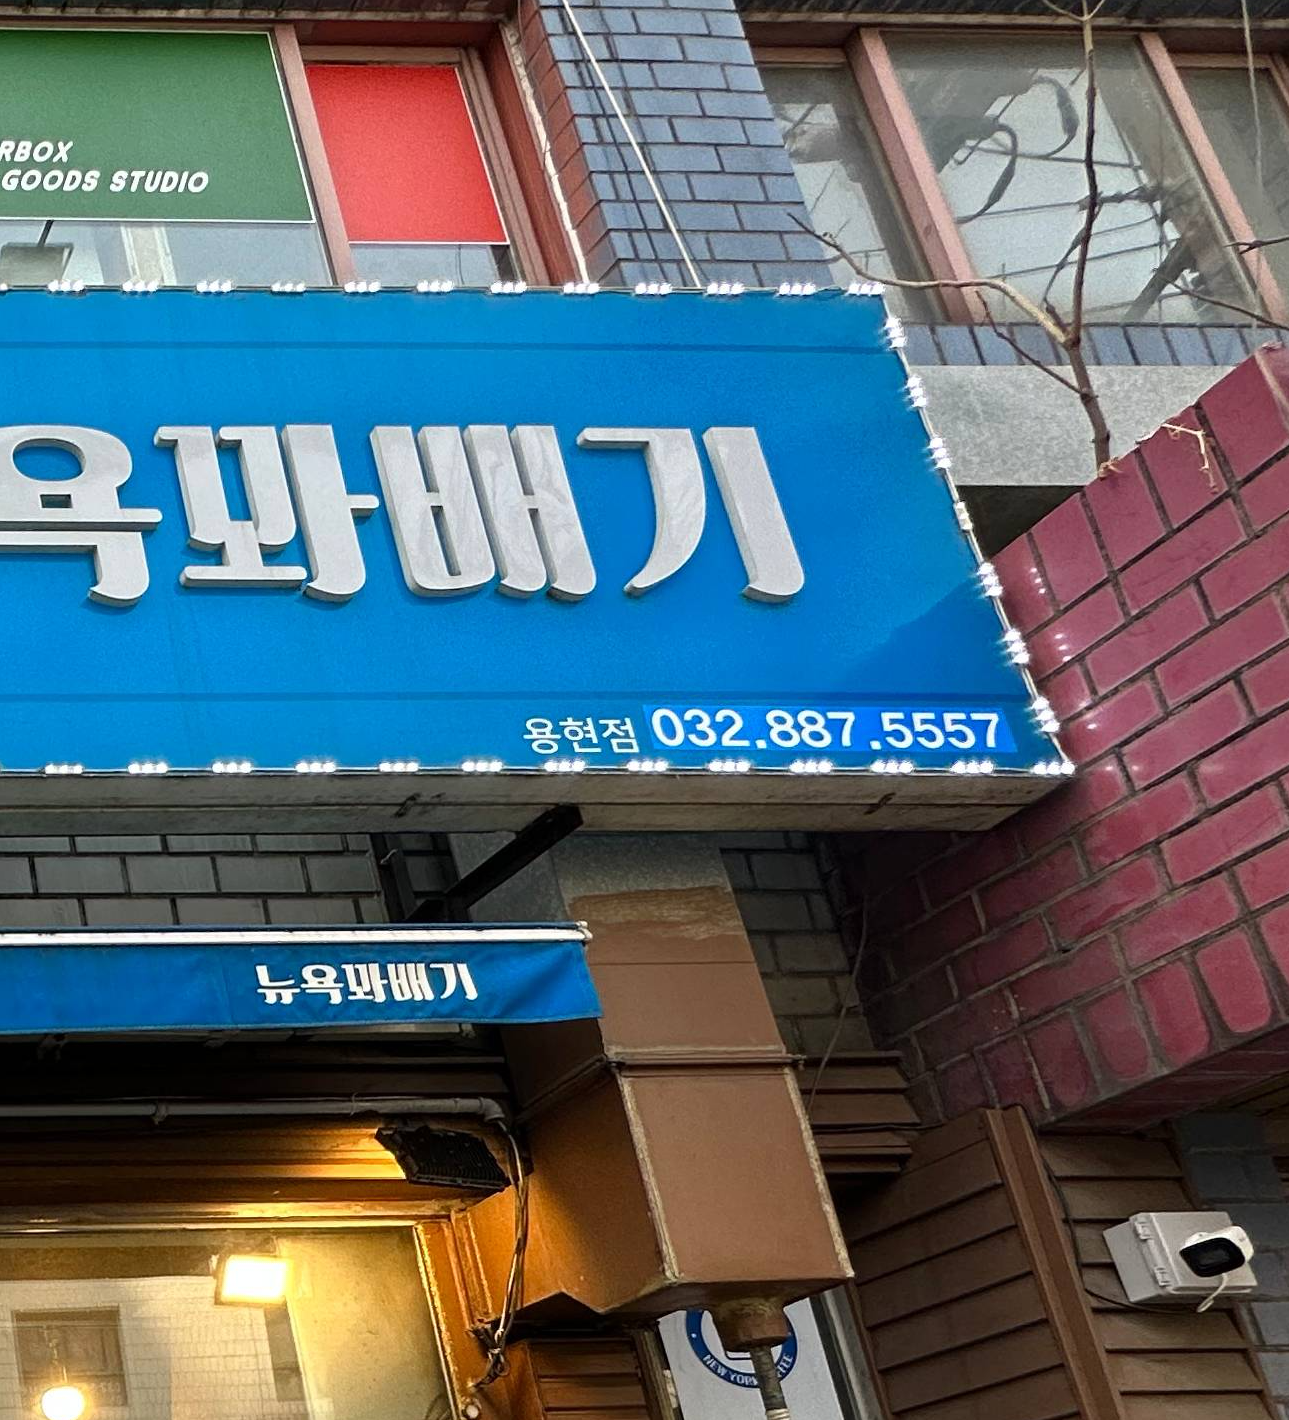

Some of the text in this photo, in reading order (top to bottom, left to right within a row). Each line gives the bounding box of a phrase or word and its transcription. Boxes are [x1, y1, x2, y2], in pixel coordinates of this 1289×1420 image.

[1, 170, 210, 193] GOODS STUDIO
[523, 716, 640, 755] 용현점
[256, 962, 476, 1006] 뉴욕꽈배기
[702, 1354, 725, 1378] NEW
